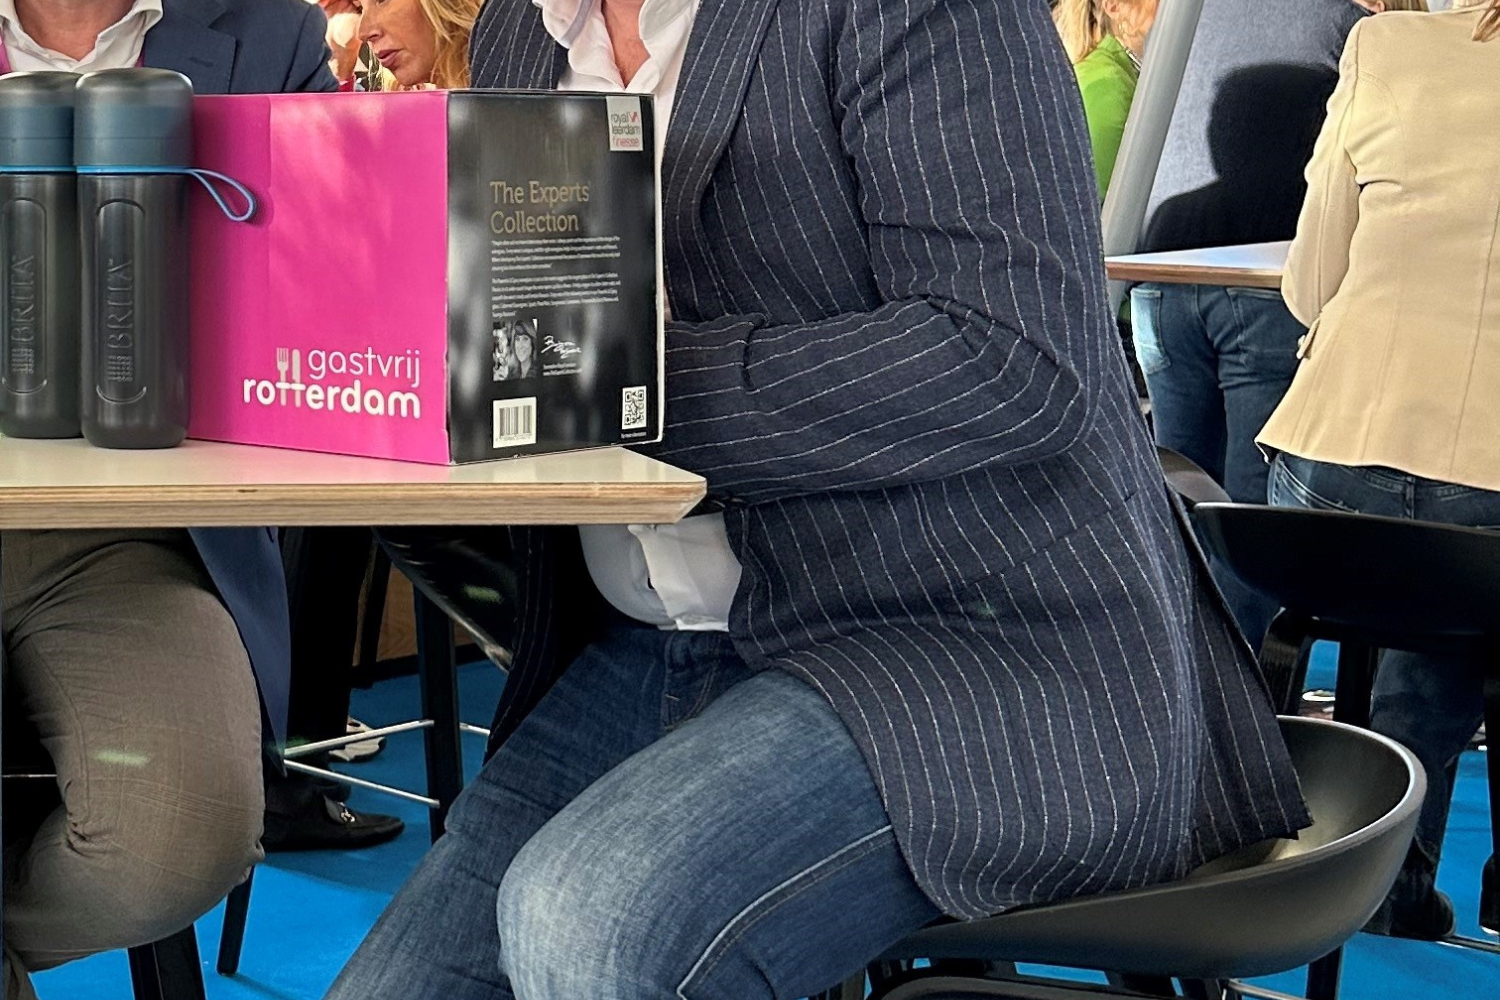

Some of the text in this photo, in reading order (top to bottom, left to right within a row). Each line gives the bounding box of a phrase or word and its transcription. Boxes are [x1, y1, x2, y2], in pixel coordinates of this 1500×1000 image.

[610, 111, 630, 127] royal
[489, 180, 525, 204] The
[489, 209, 580, 234] Collection
[10, 254, 35, 342] BRITA
[107, 259, 134, 349] BRITA
[307, 345, 421, 389] gastvrij
[242, 378, 422, 420] rotterdam
